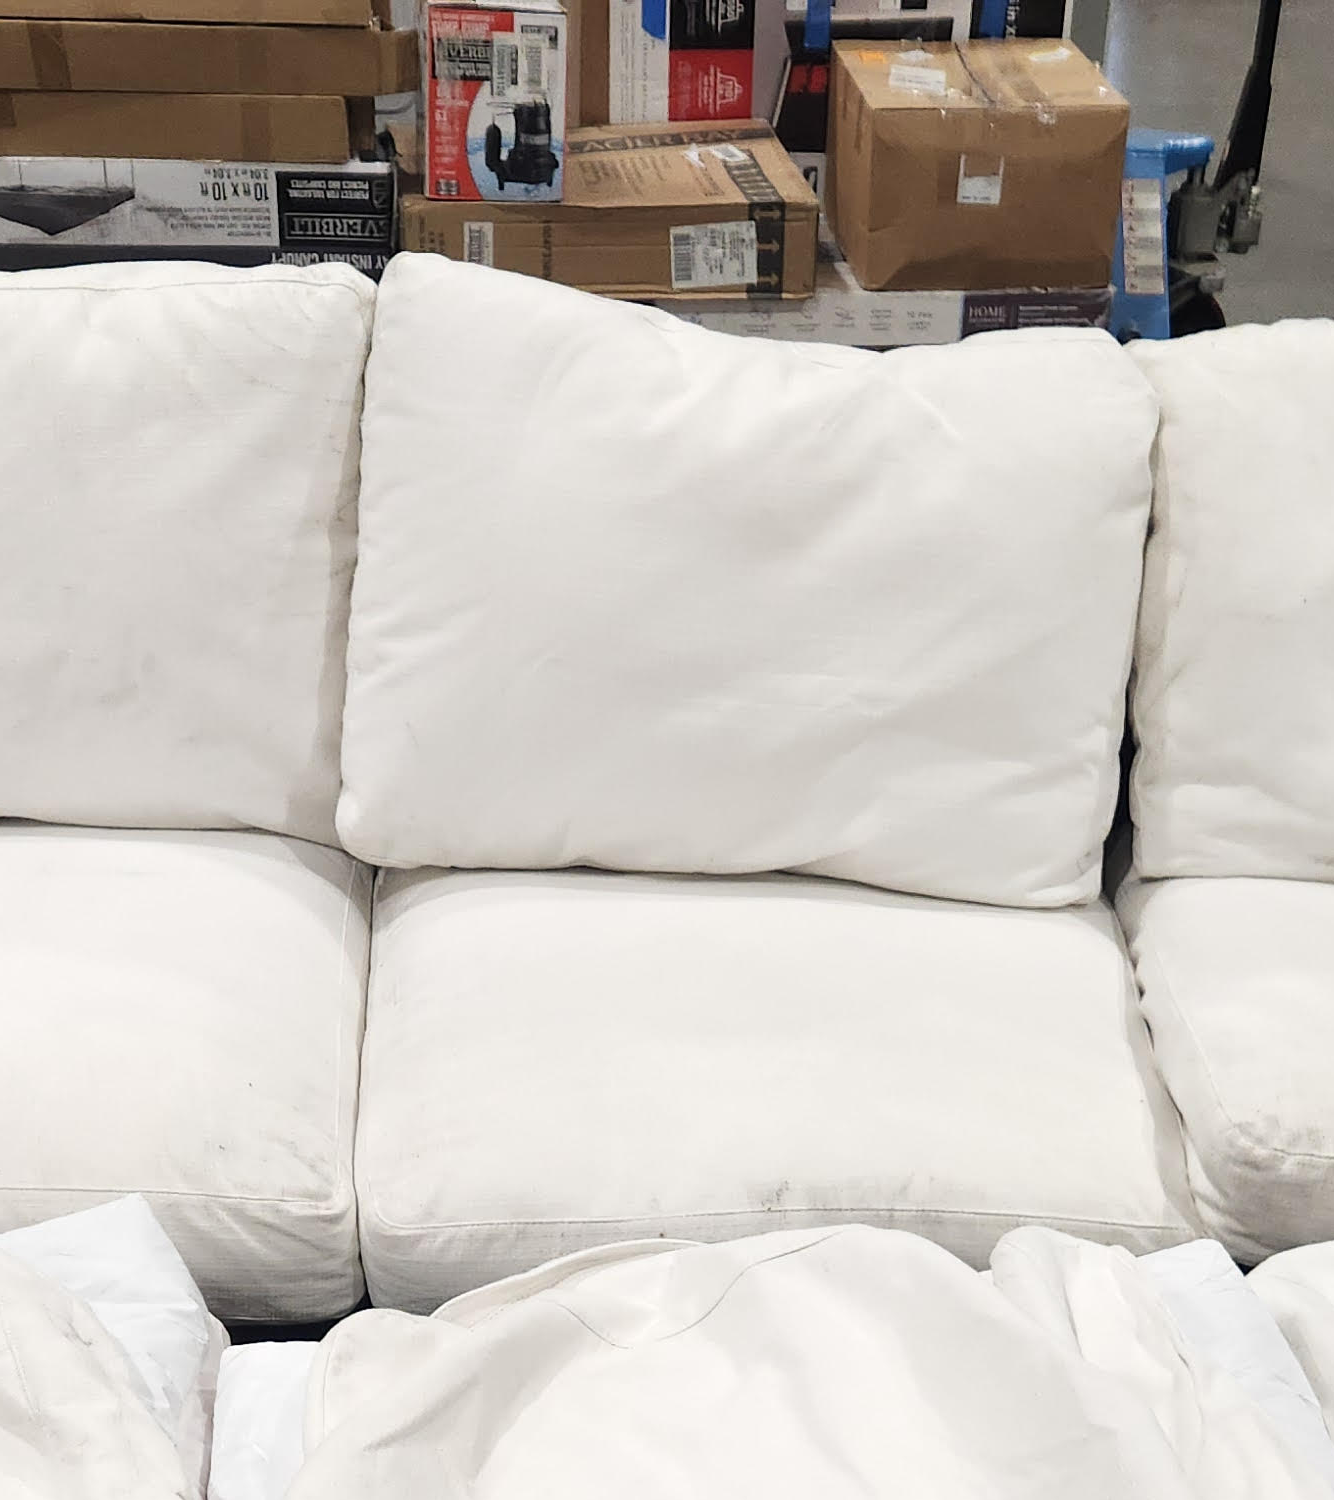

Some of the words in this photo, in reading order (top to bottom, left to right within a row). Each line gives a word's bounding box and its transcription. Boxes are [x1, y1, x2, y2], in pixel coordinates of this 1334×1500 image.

[211, 182, 227, 201] 10
[254, 182, 270, 201] 10
[271, 252, 319, 267] CANOPY
[969, 305, 1006, 317] HOME
